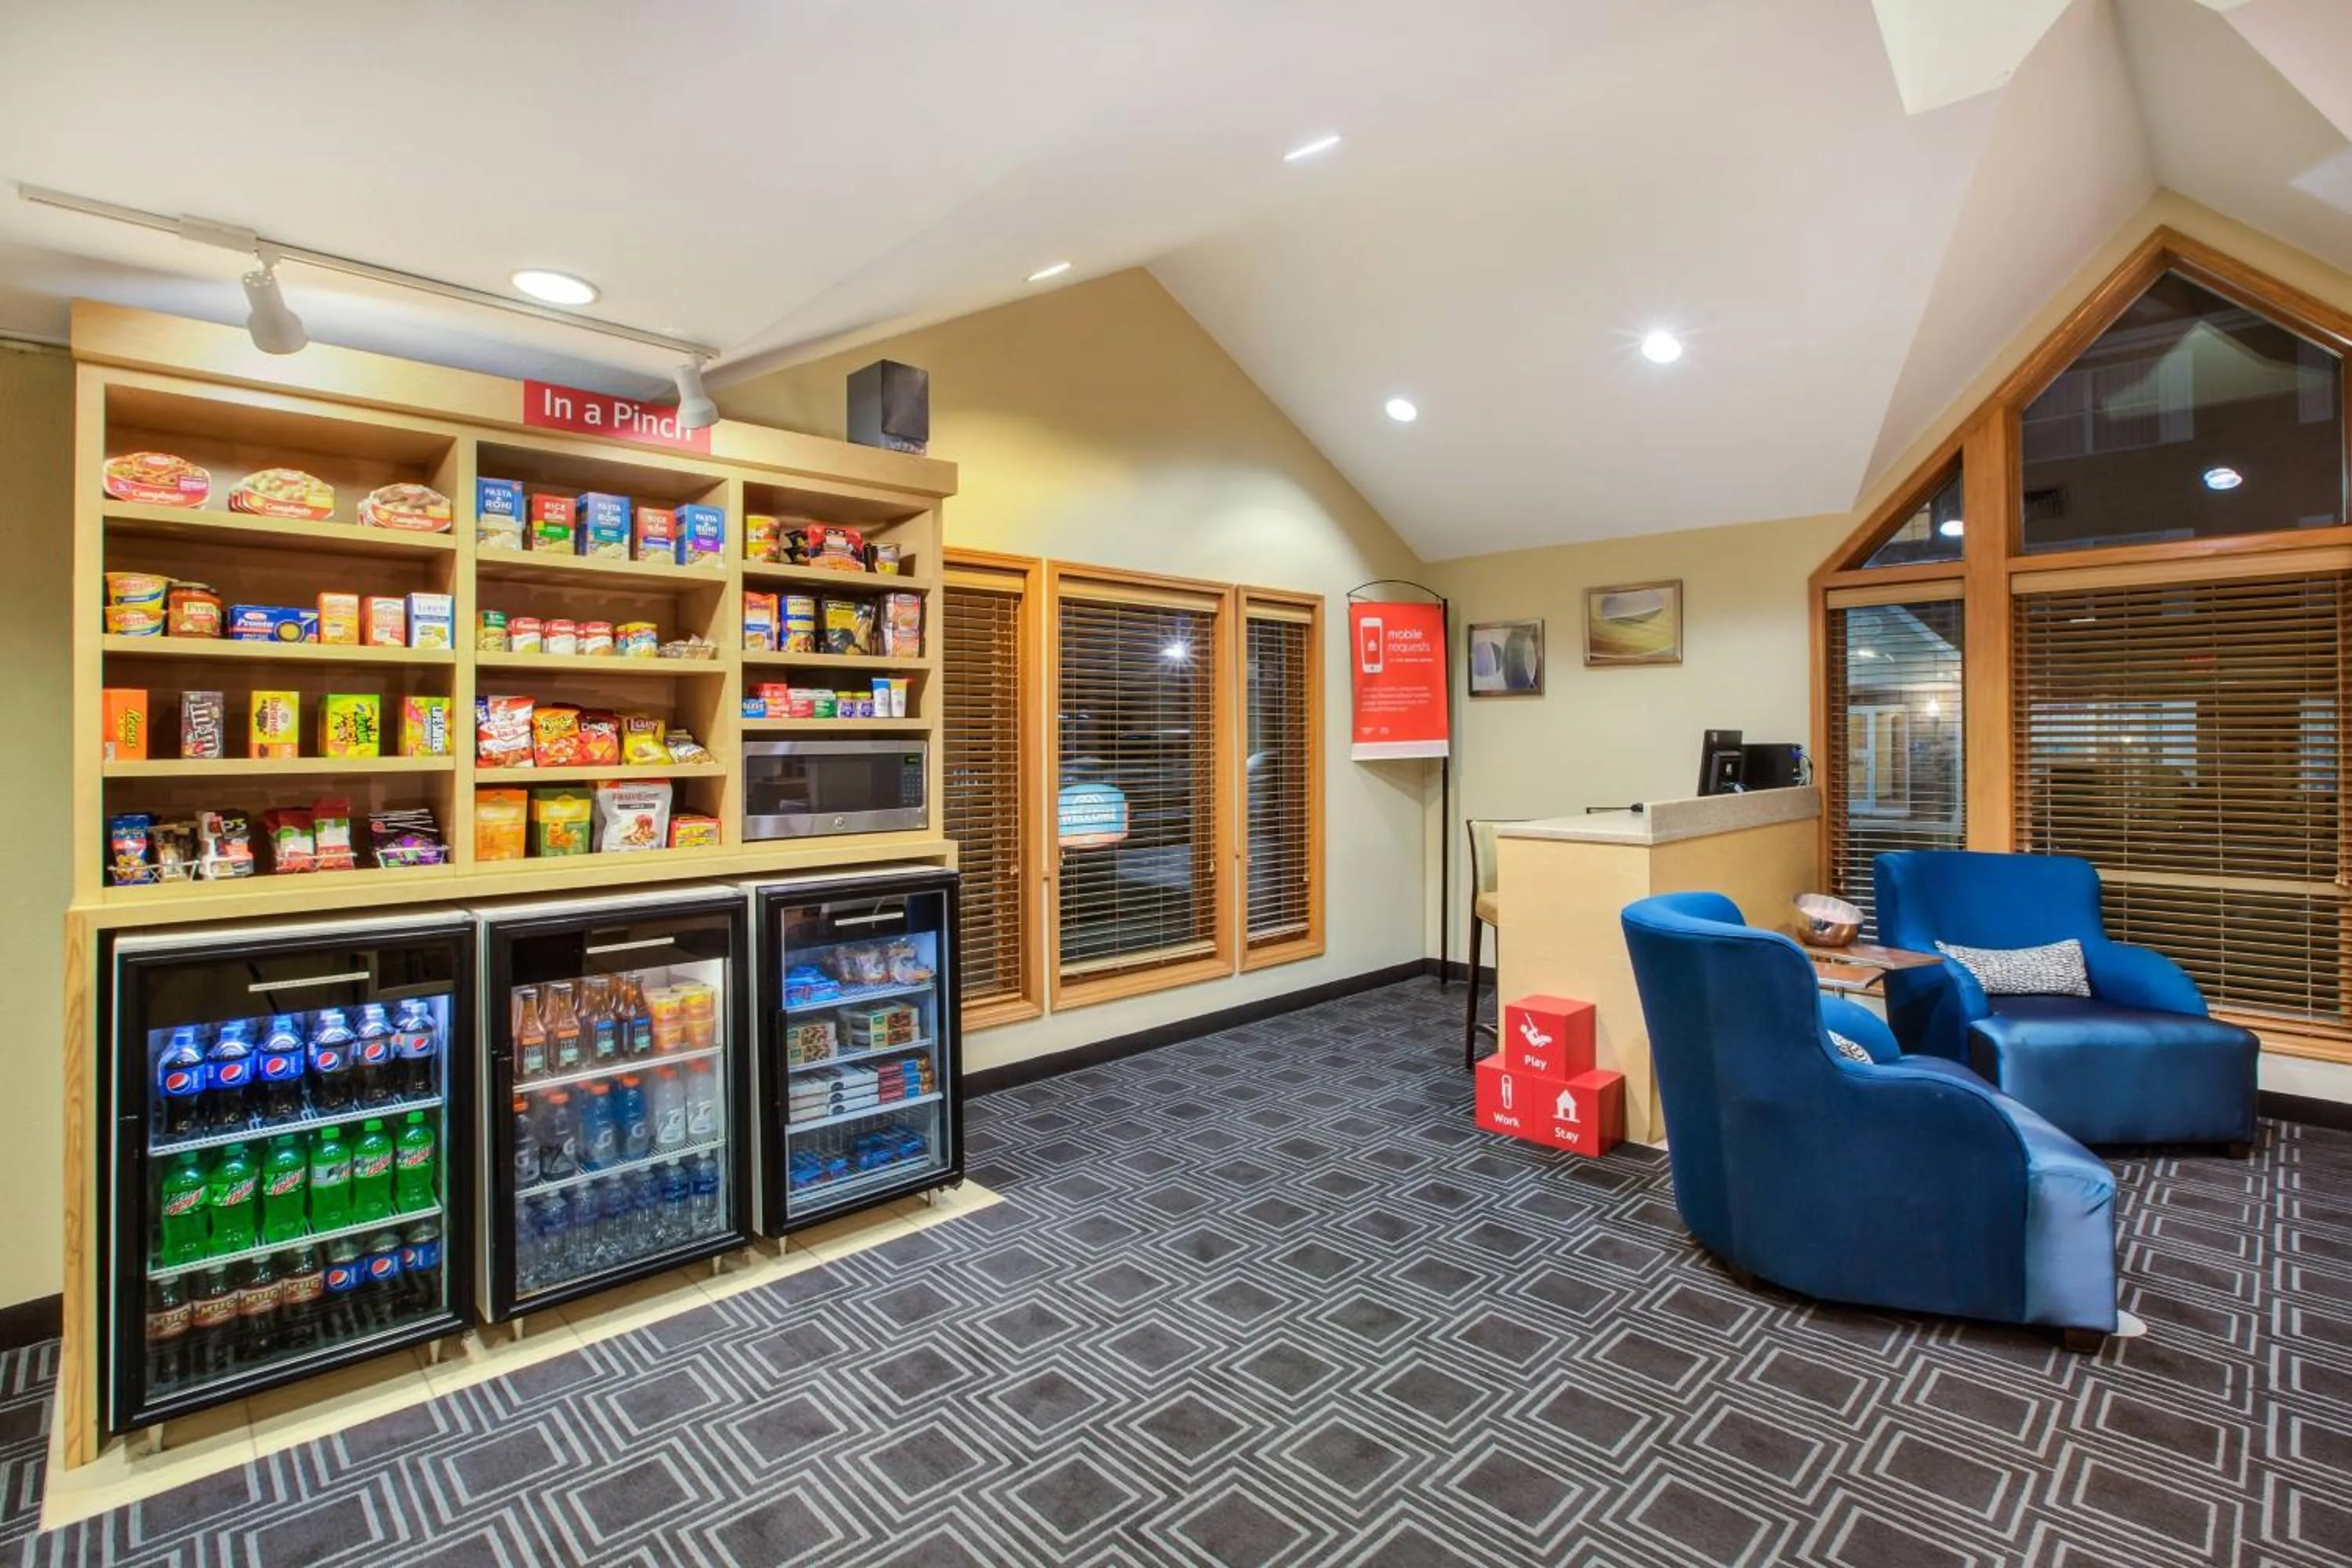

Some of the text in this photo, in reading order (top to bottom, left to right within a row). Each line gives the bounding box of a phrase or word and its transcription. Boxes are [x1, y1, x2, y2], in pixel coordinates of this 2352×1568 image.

[545, 389, 572, 420] In
[584, 403, 601, 425] a
[485, 488, 512, 498] PASTA
[1388, 628, 1423, 640] mobile
[1388, 642, 1431, 653] requests
[1523, 1054, 1548, 1071] Play
[1494, 1112, 1520, 1127] Work
[1555, 1127, 1579, 1145] Stay
